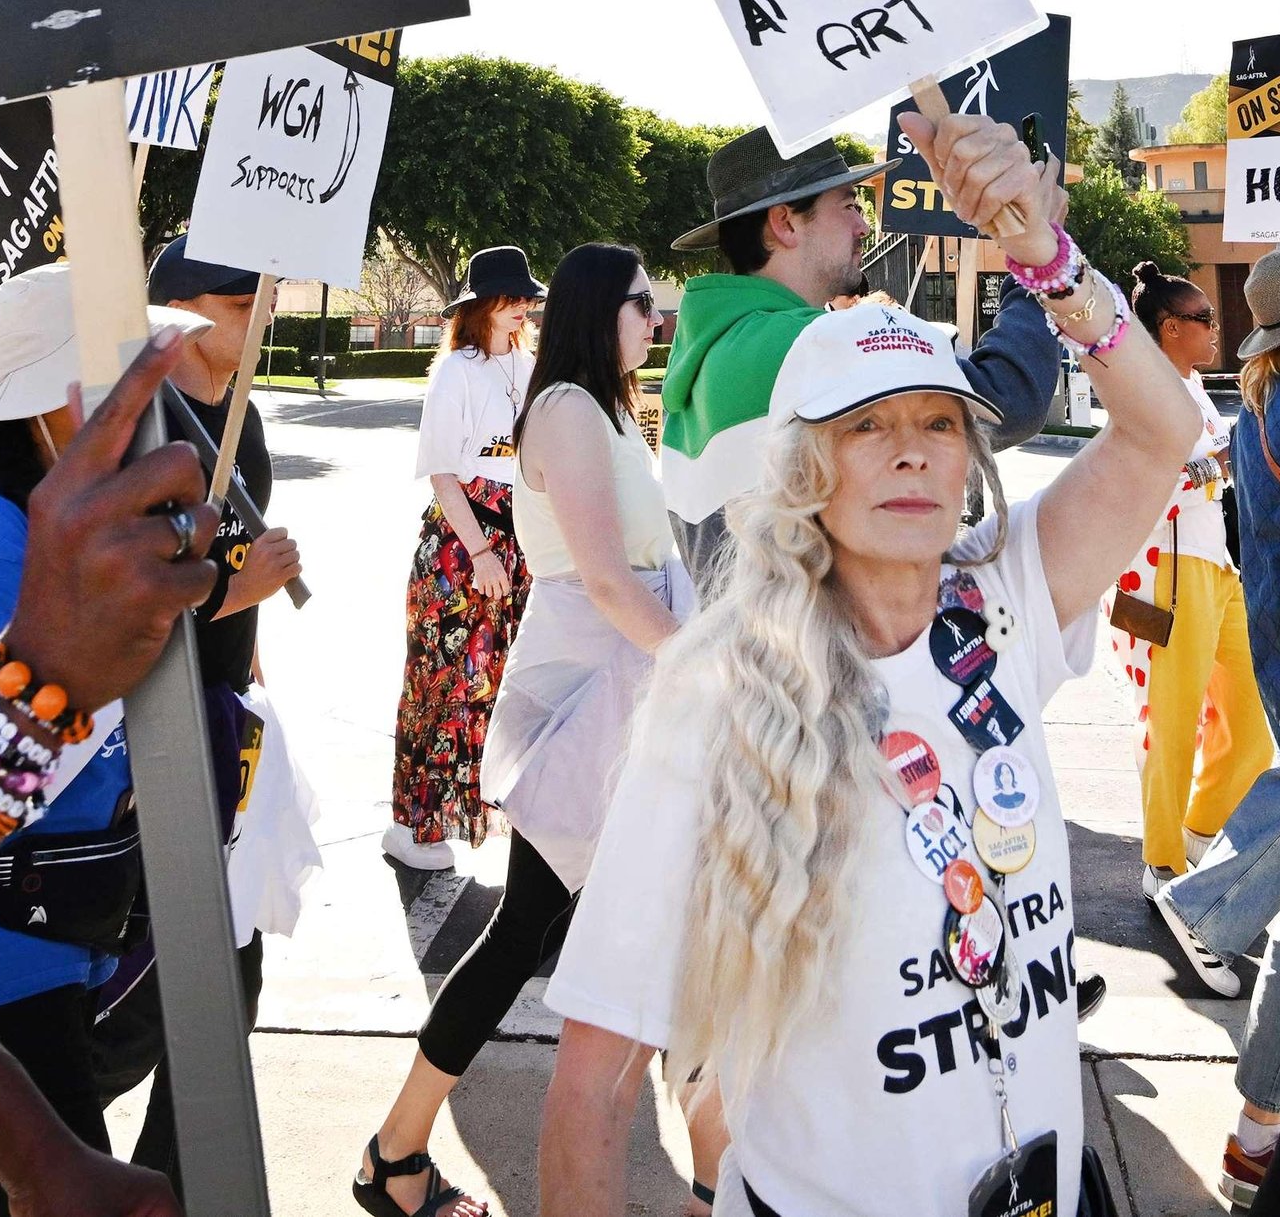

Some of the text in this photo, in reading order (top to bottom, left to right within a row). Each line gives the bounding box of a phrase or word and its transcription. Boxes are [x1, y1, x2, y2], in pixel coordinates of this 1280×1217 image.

[258, 74, 324, 142] WGA
[1237, 95, 1266, 132] ON
[231, 155, 315, 204] SUPPORTS
[856, 334, 935, 350] NEGOTIATING
[862, 343, 934, 356] COMMITTEE
[912, 823, 933, 849] I
[925, 826, 967, 877] DCI
